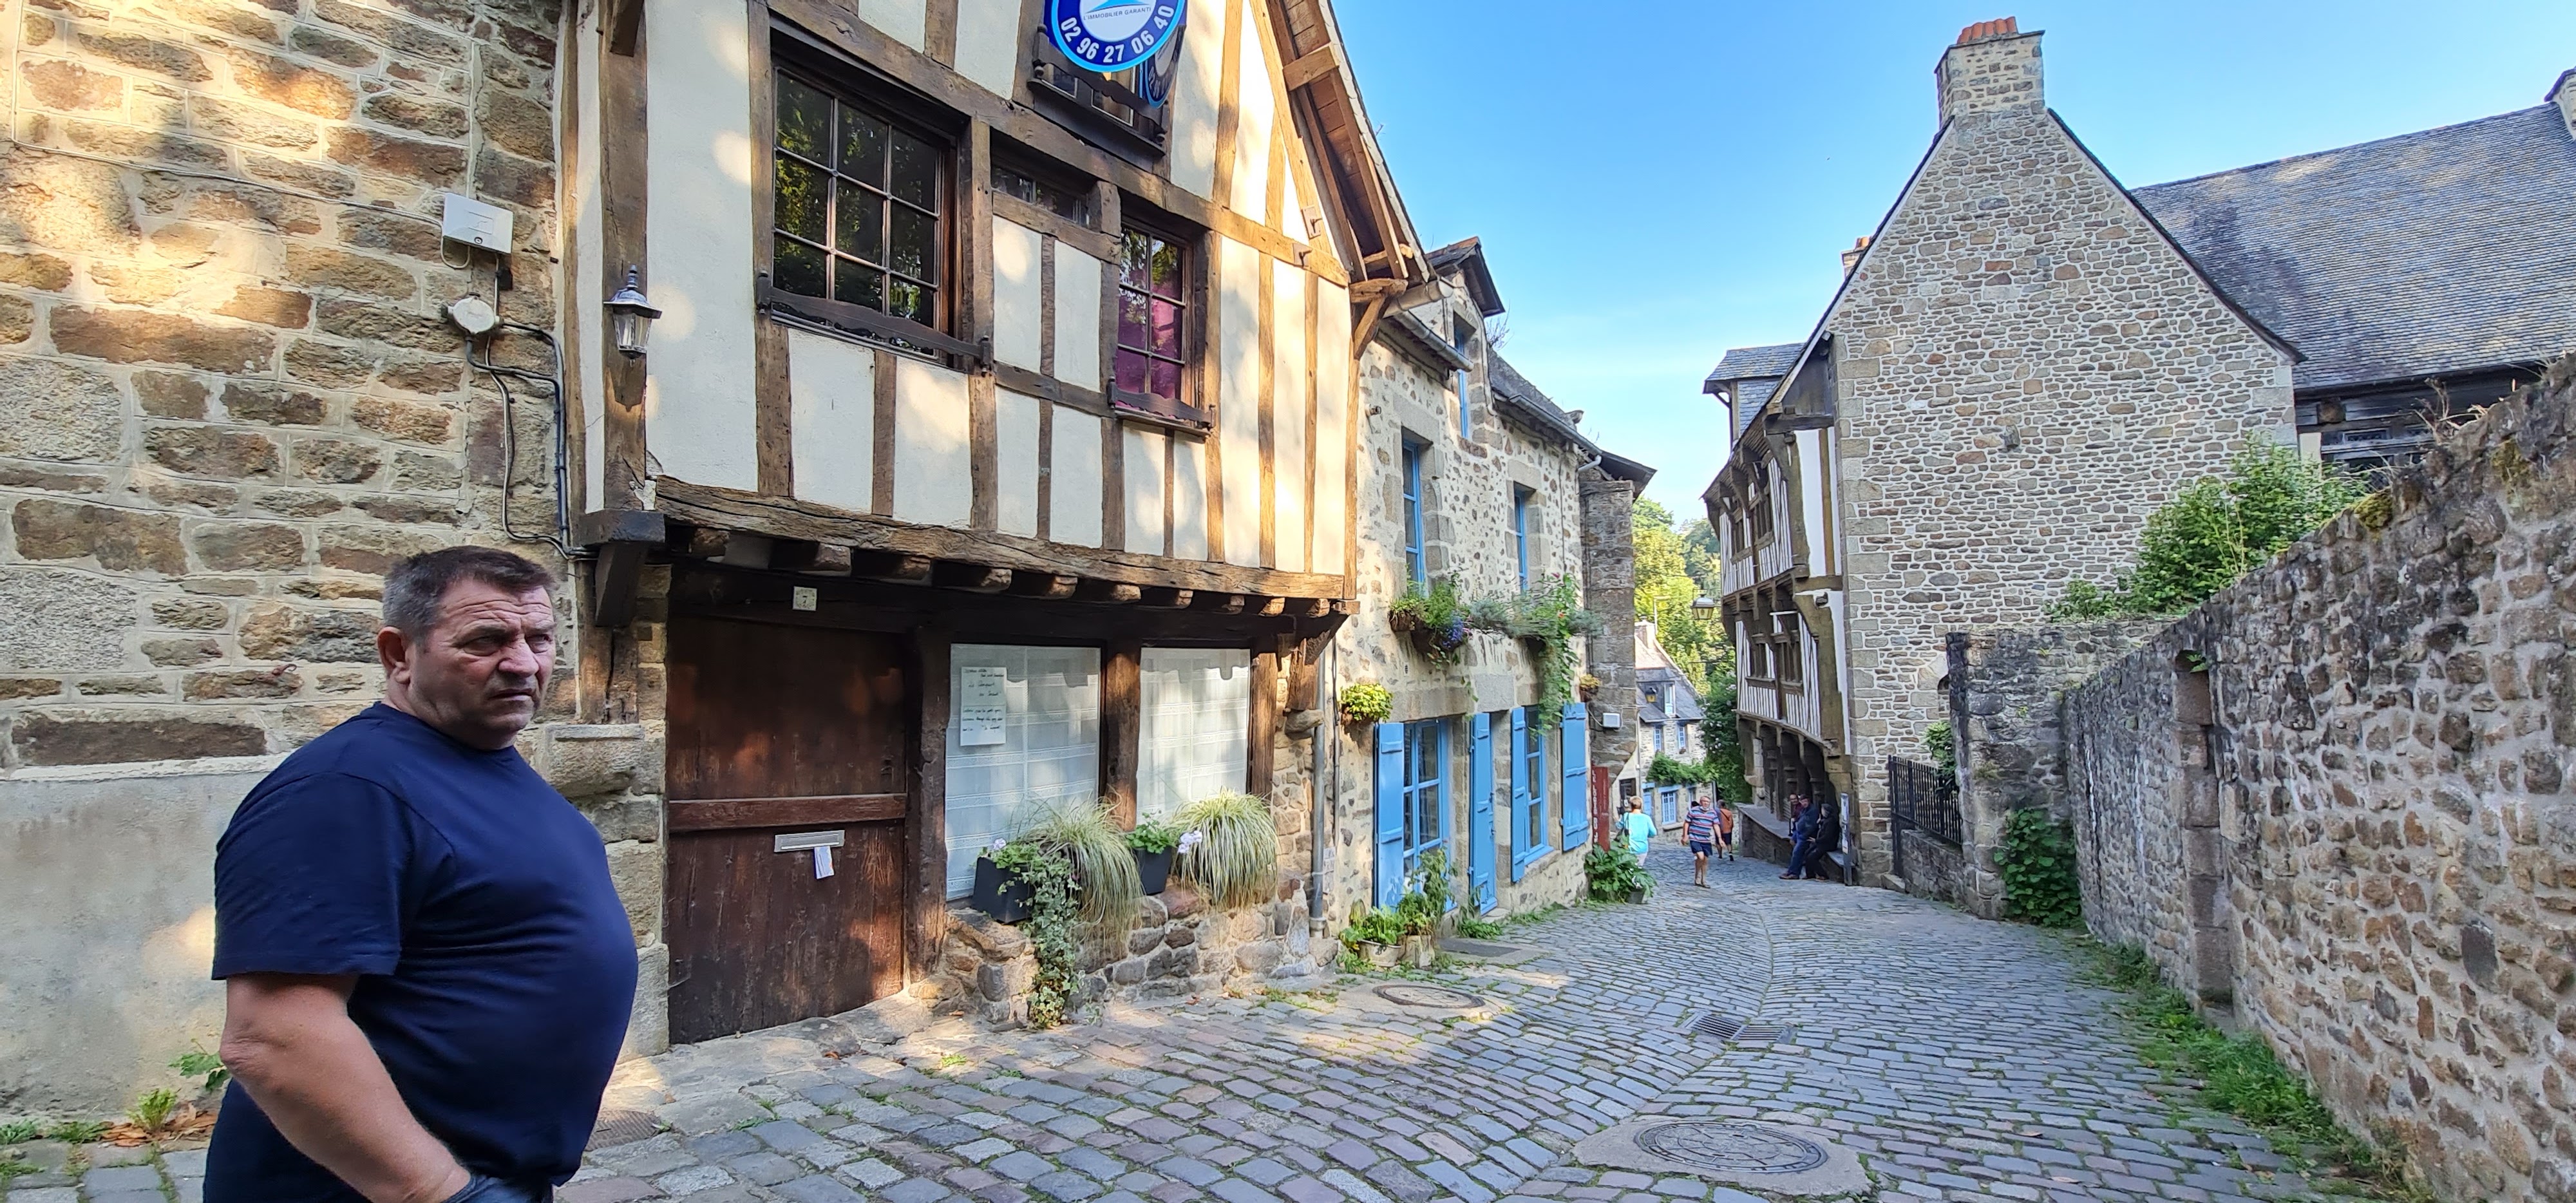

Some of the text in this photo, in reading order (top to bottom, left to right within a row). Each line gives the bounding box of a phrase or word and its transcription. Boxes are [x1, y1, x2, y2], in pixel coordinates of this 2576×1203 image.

[1083, 7, 1151, 21] L'IMMOBILIER GARANTI
[1061, 17, 1081, 43] 02
[1076, 37, 1099, 60] 96
[1103, 44, 1124, 63] 27
[1131, 30, 1154, 54] 06
[1153, 5, 1174, 30] 40
[802, 595, 808, 604] 7
